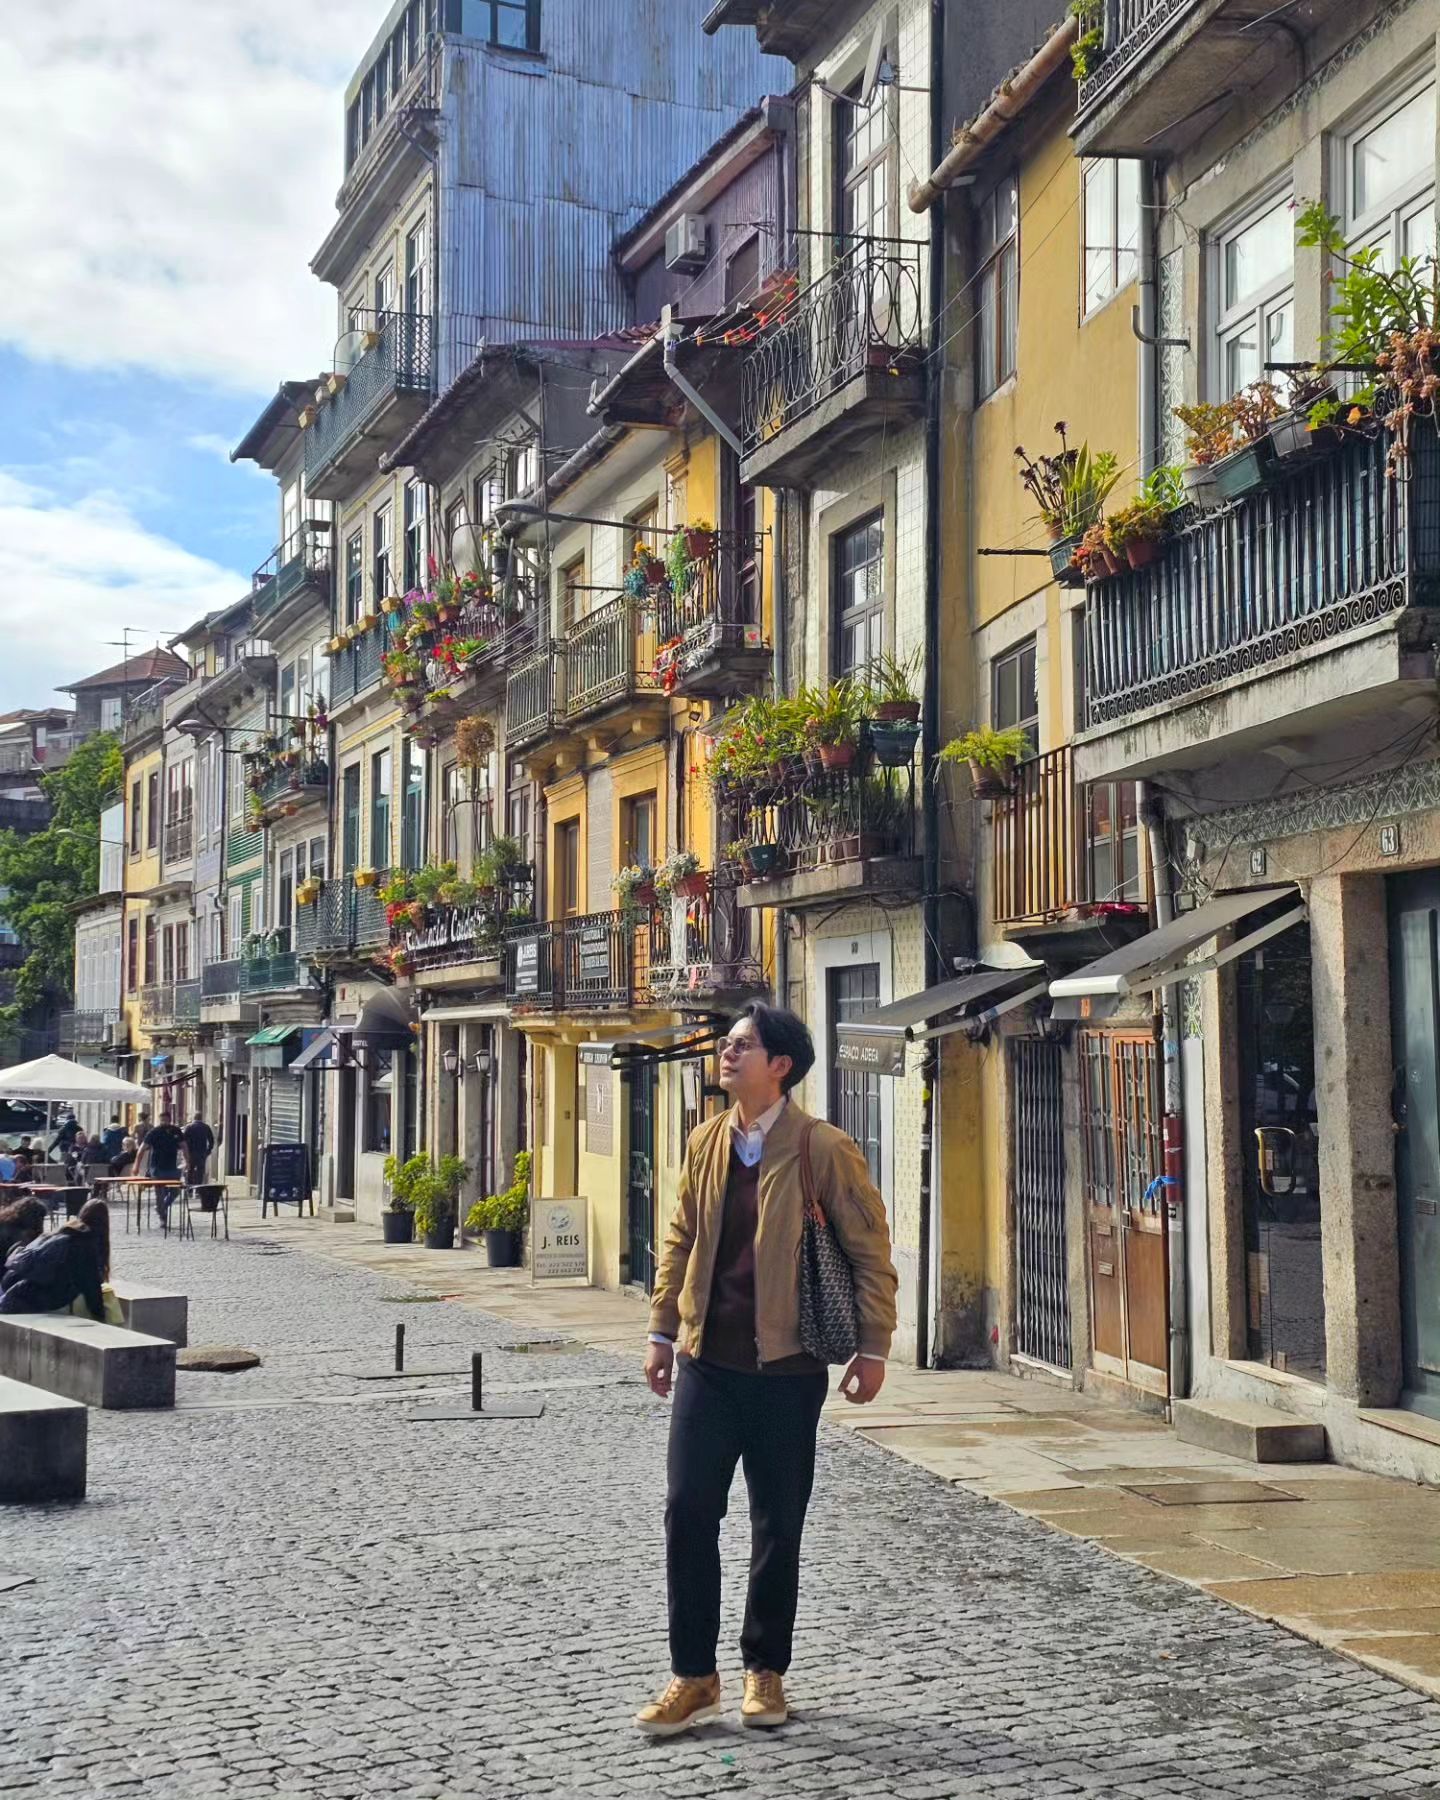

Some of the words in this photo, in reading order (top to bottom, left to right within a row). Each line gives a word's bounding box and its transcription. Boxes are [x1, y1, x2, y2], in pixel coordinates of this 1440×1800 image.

[1382, 827, 1395, 853] 63
[1252, 851, 1261, 873] 62
[861, 1047, 879, 1062] ADEGA
[541, 1235, 551, 1249] J.
[556, 1234, 580, 1247] REIS
